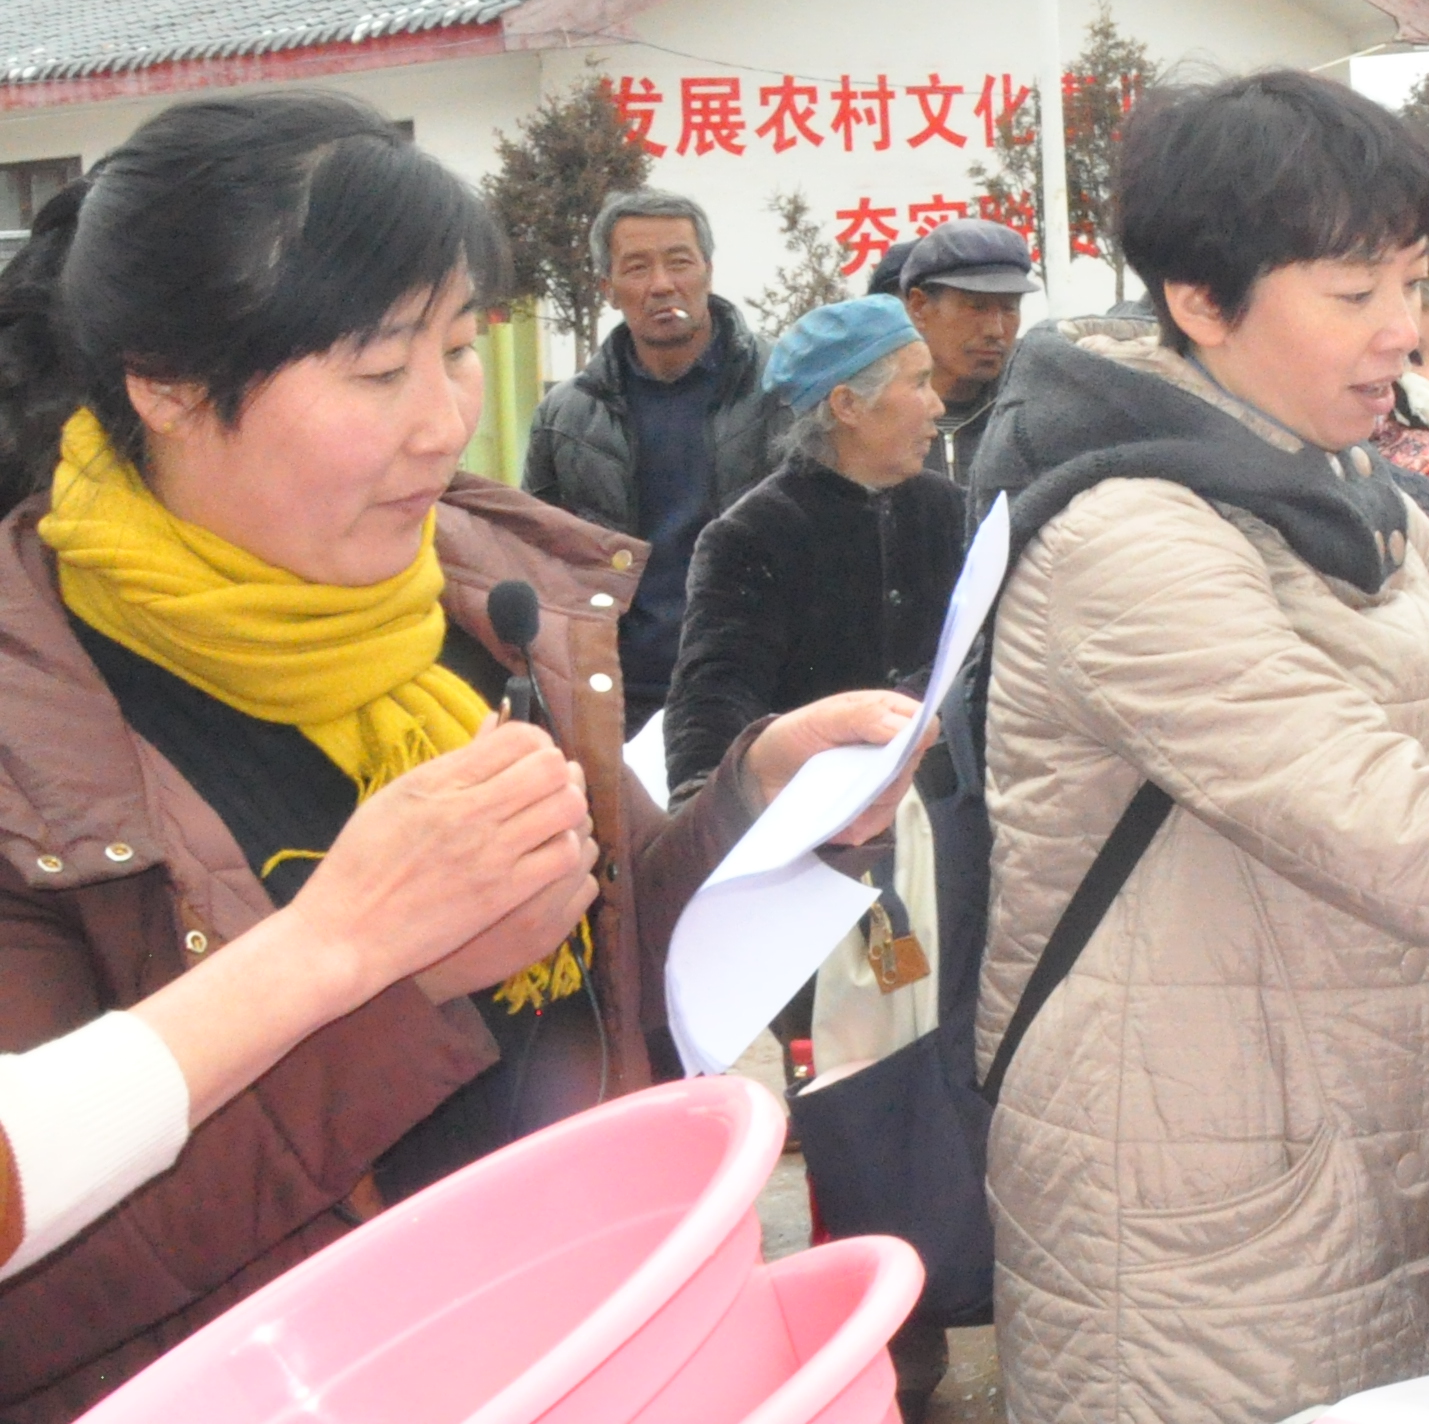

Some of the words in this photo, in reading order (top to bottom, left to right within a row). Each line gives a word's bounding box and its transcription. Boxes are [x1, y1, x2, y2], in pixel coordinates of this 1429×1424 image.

[603, 72, 1146, 159] 发展农村文化
